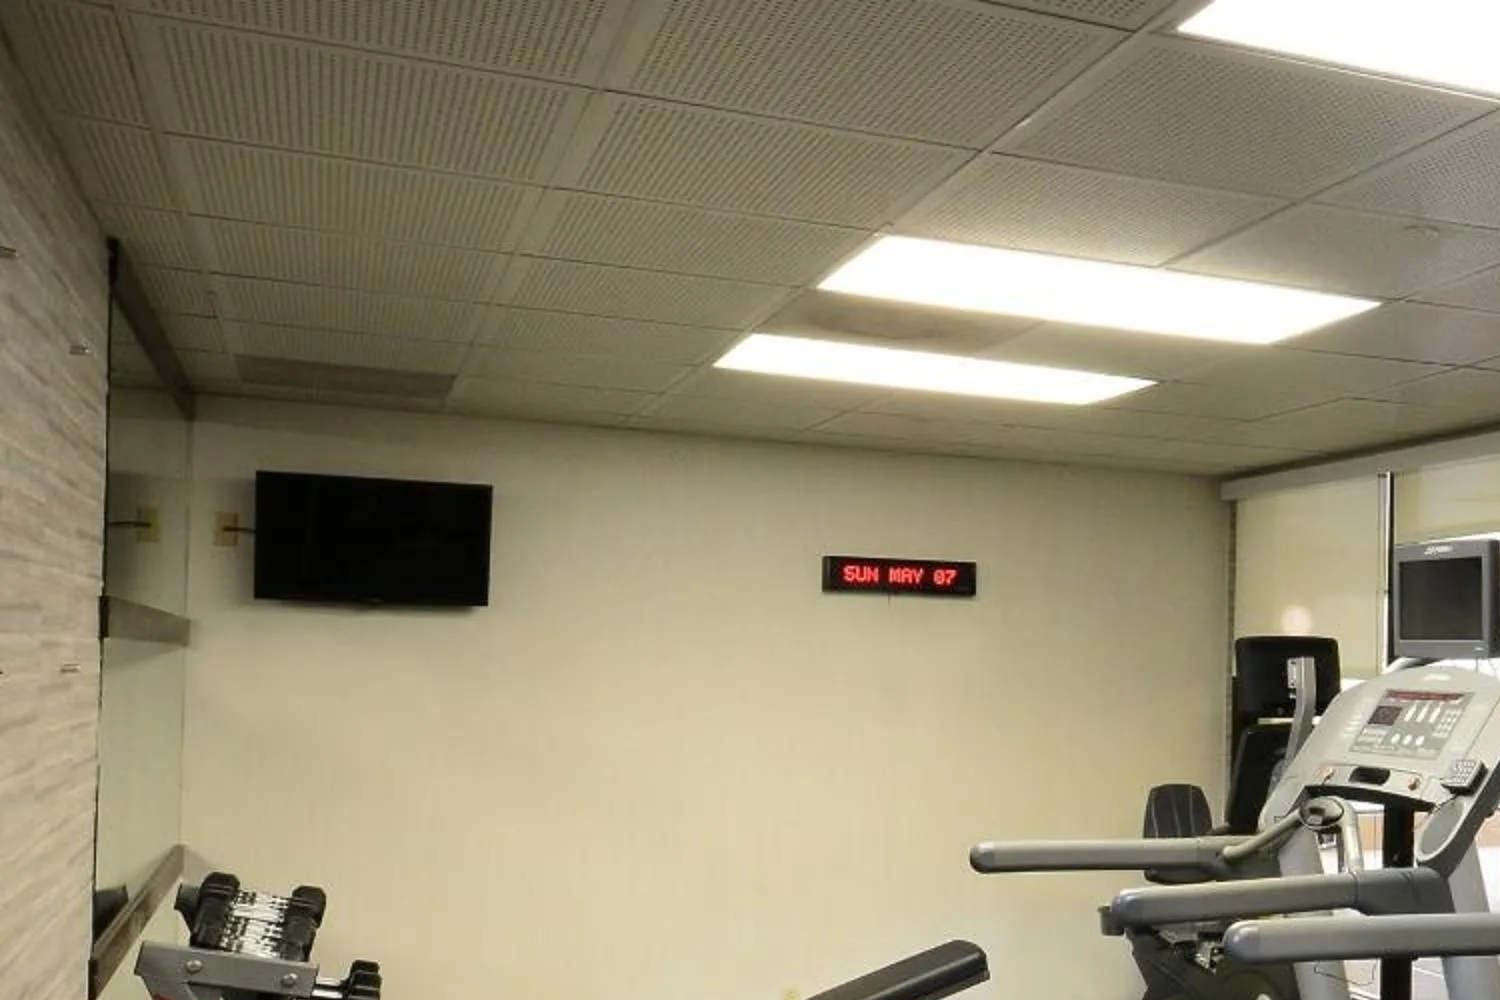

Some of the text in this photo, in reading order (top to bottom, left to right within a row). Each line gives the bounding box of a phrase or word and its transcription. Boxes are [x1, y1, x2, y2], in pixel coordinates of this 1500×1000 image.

[843, 565, 957, 585] SUN MAY 07
